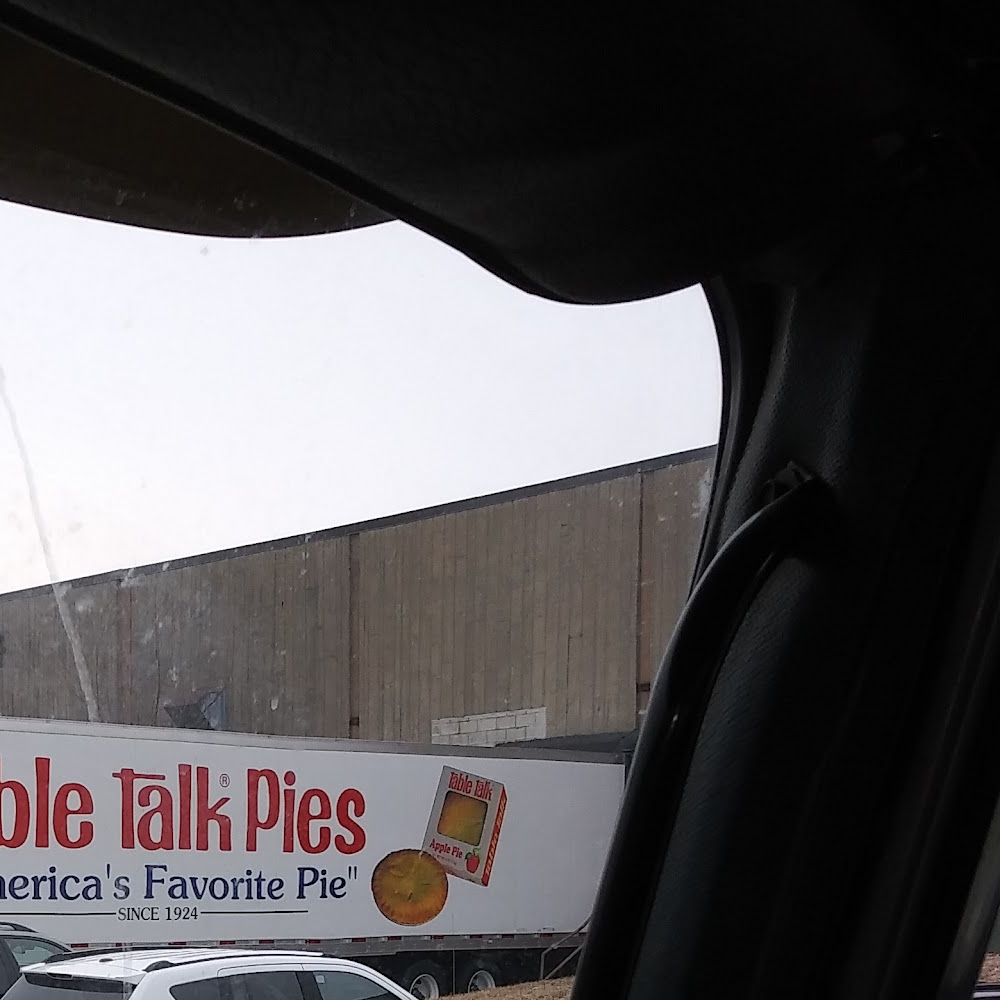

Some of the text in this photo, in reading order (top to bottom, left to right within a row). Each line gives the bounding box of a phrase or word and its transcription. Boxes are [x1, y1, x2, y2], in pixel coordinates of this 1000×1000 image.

[448, 771, 493, 801] Table Talk
[112, 763, 232, 852] Talk
[246, 768, 367, 855] Pies
[429, 838, 463, 858] Apple Pie
[143, 865, 285, 901] Favorite
[296, 866, 358, 900] Pie"
[117, 907, 199, 922] SINCE 1924
